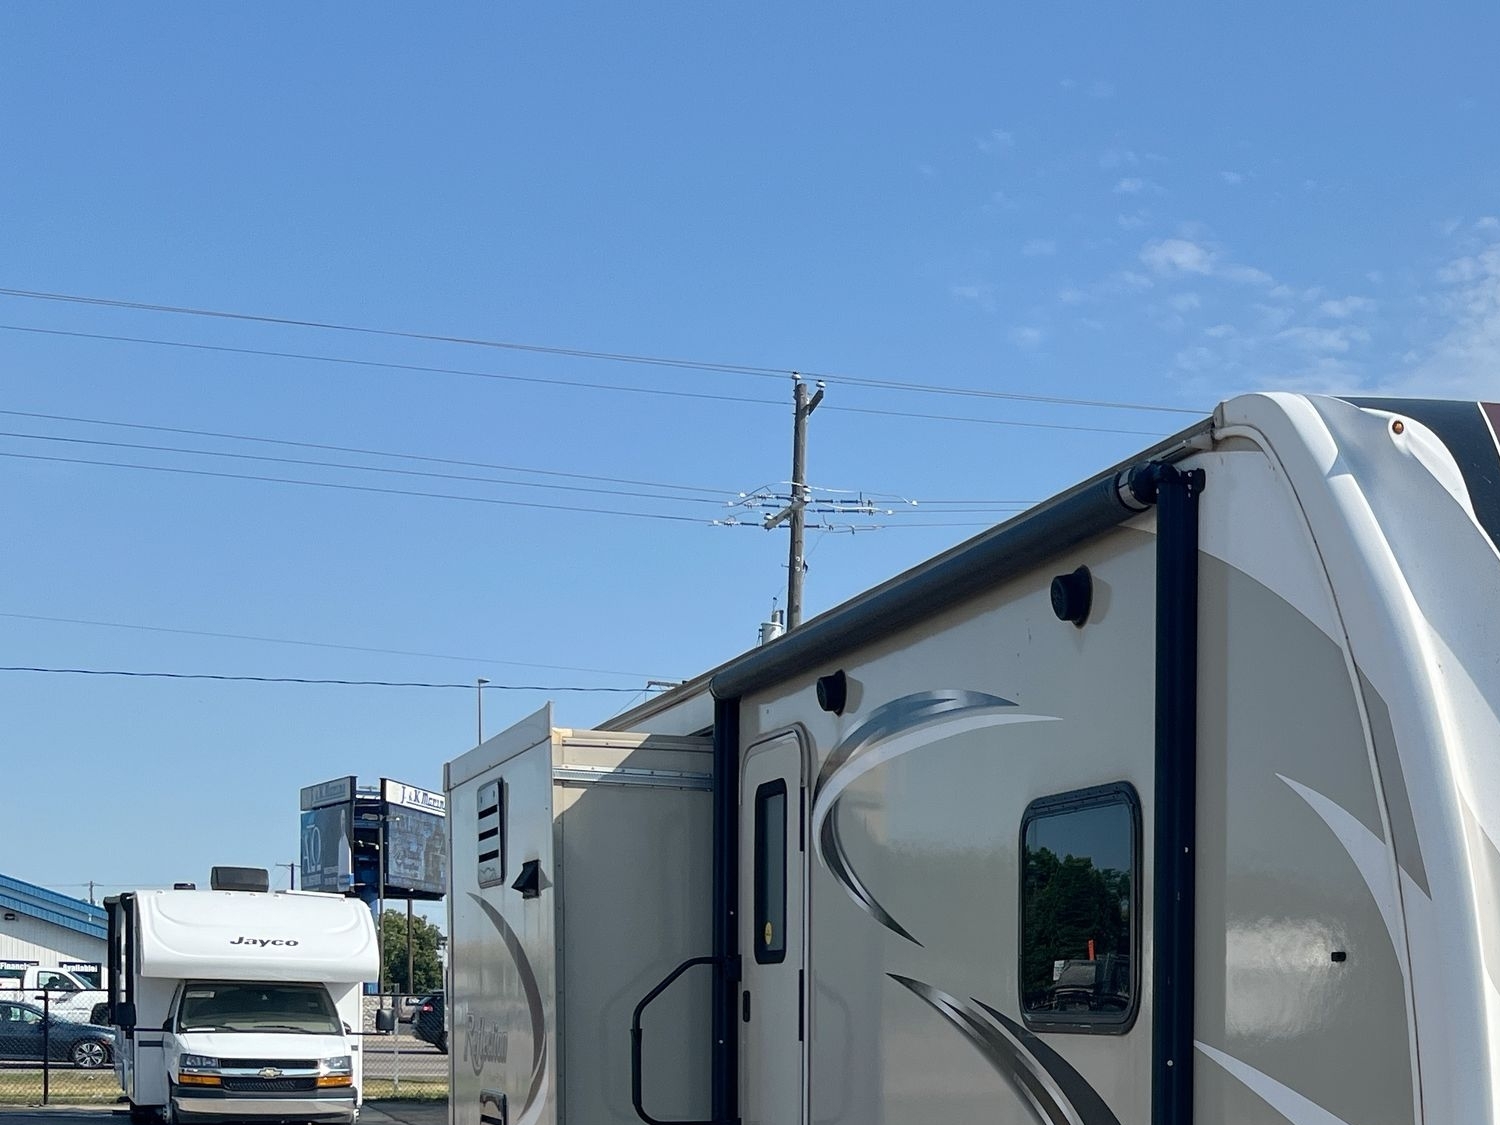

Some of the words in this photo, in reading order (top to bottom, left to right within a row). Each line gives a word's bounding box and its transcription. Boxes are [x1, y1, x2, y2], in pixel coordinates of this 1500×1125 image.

[401, 785, 406, 804] J
[414, 790, 420, 803] K
[230, 936, 299, 948] Jayco
